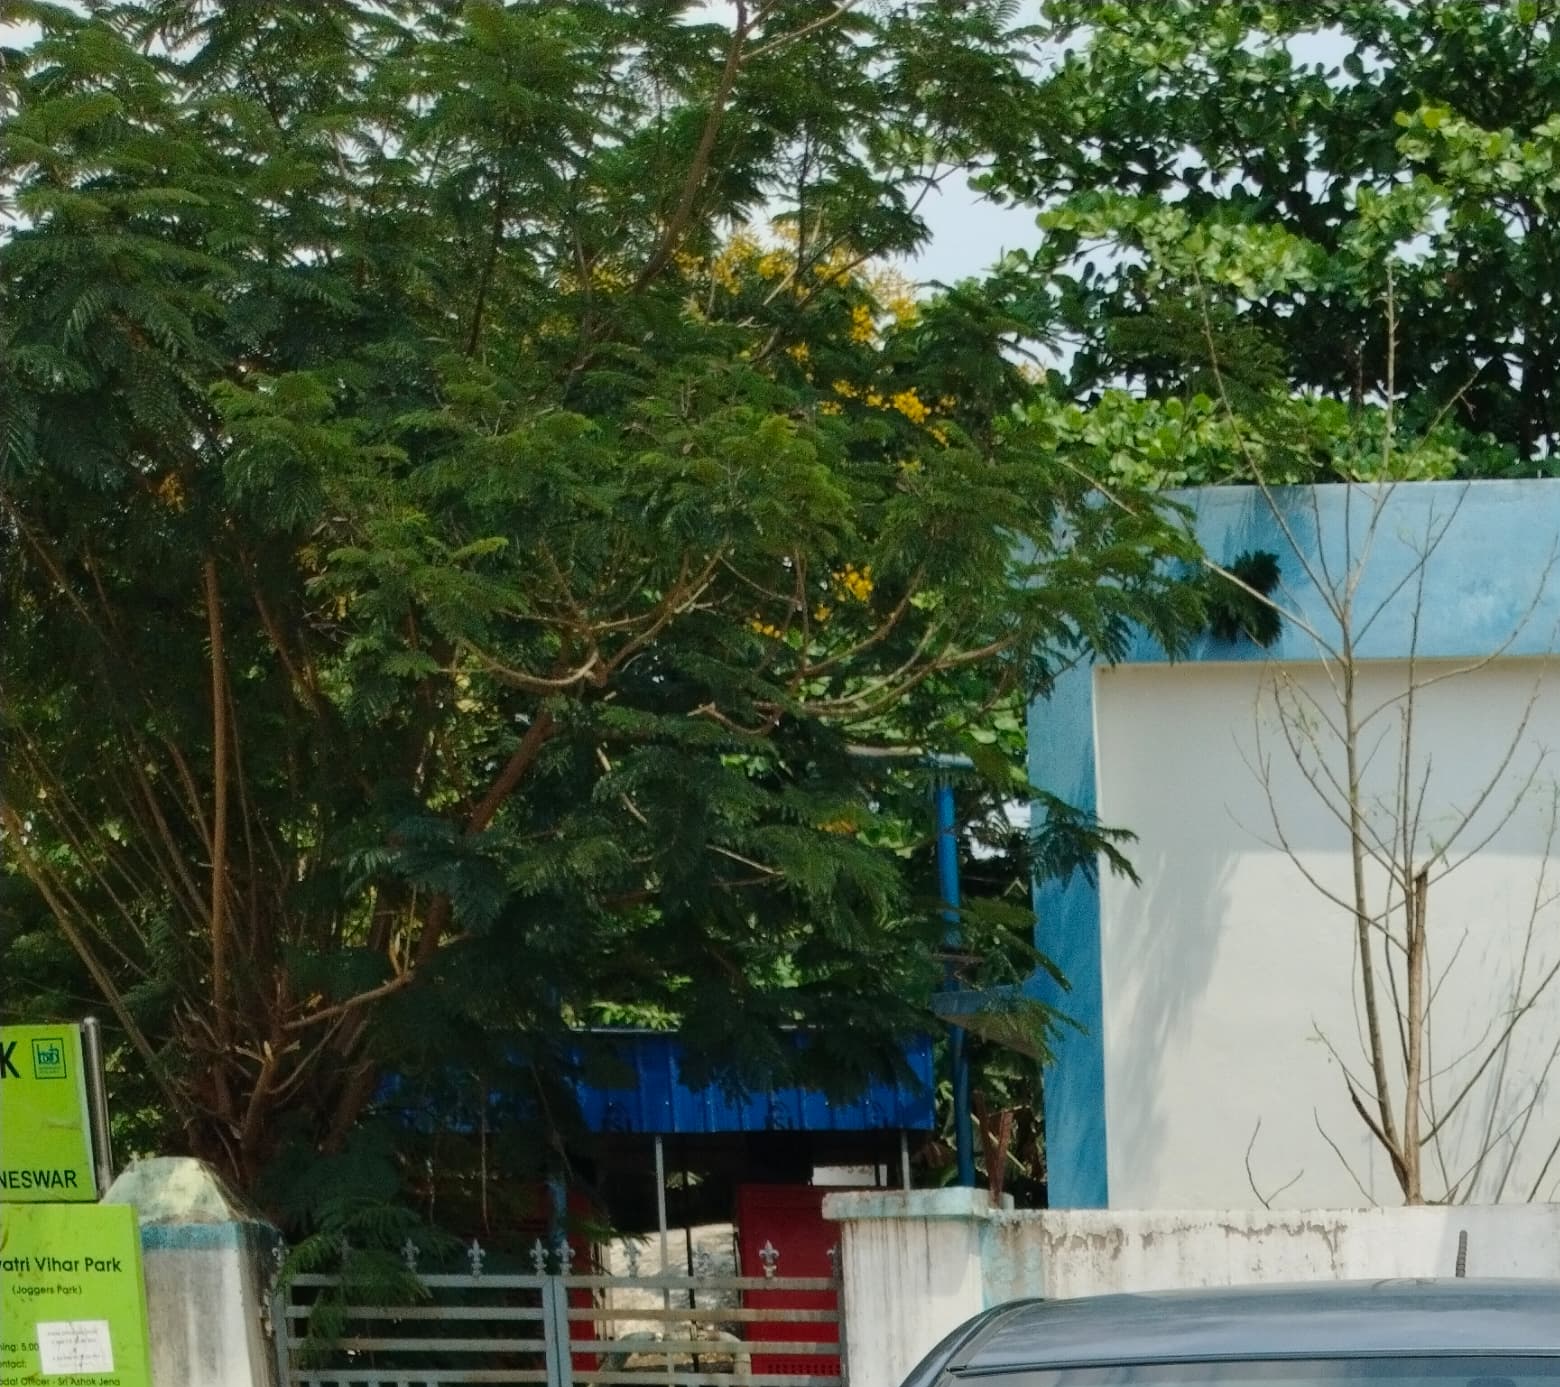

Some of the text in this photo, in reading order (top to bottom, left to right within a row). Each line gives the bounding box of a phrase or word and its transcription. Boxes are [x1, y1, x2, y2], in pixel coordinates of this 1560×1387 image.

[0, 1041, 20, 1079] K
[0, 1256, 122, 1272] atri Vihar Park
[12, 1285, 82, 1296] (Joggers Park)
[20, 1376, 50, 1386] Officer
[70, 1376, 96, 1386] Ashok
